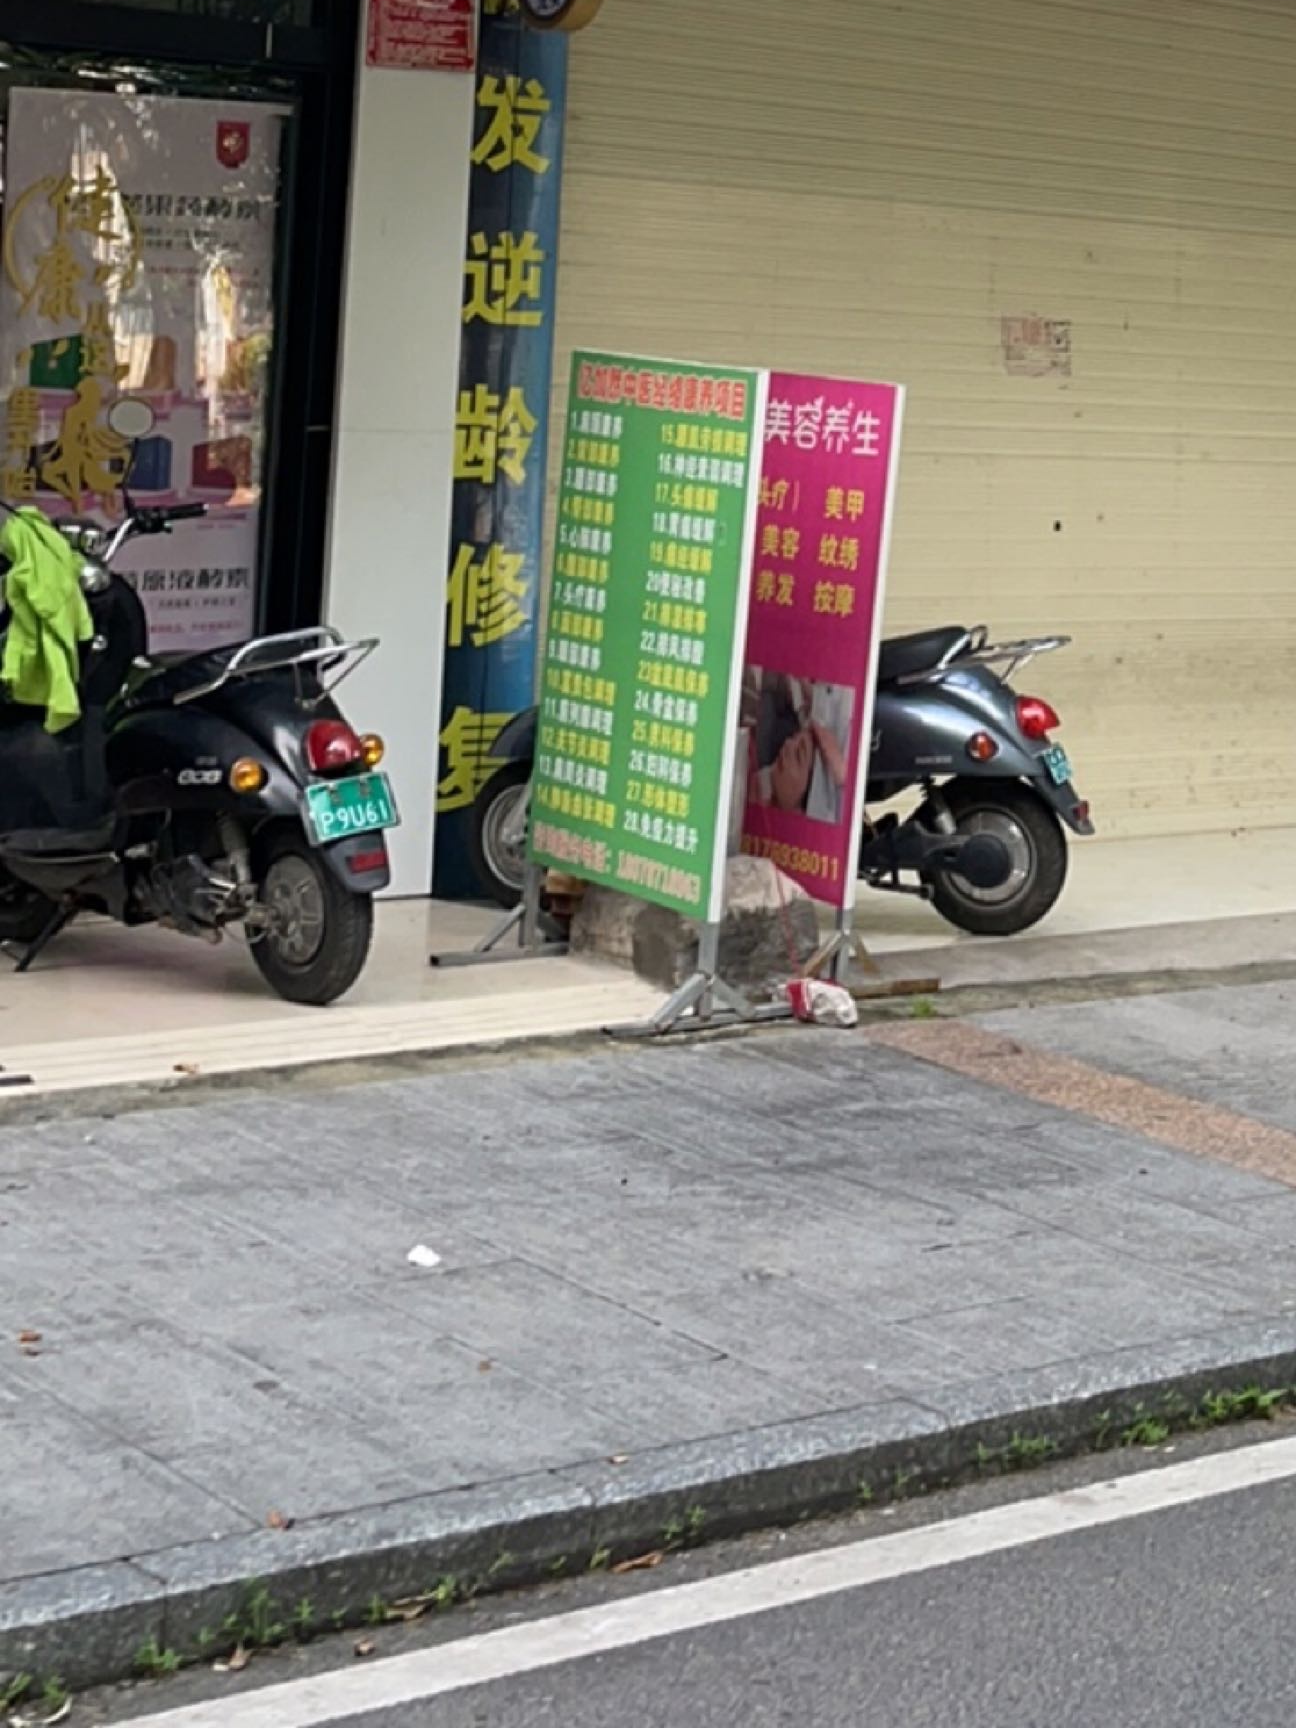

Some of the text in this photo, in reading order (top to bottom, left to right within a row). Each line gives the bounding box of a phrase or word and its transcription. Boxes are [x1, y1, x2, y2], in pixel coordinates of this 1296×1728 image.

[763, 395, 882, 457] 美容养生
[823, 485, 865, 522] 美甲
